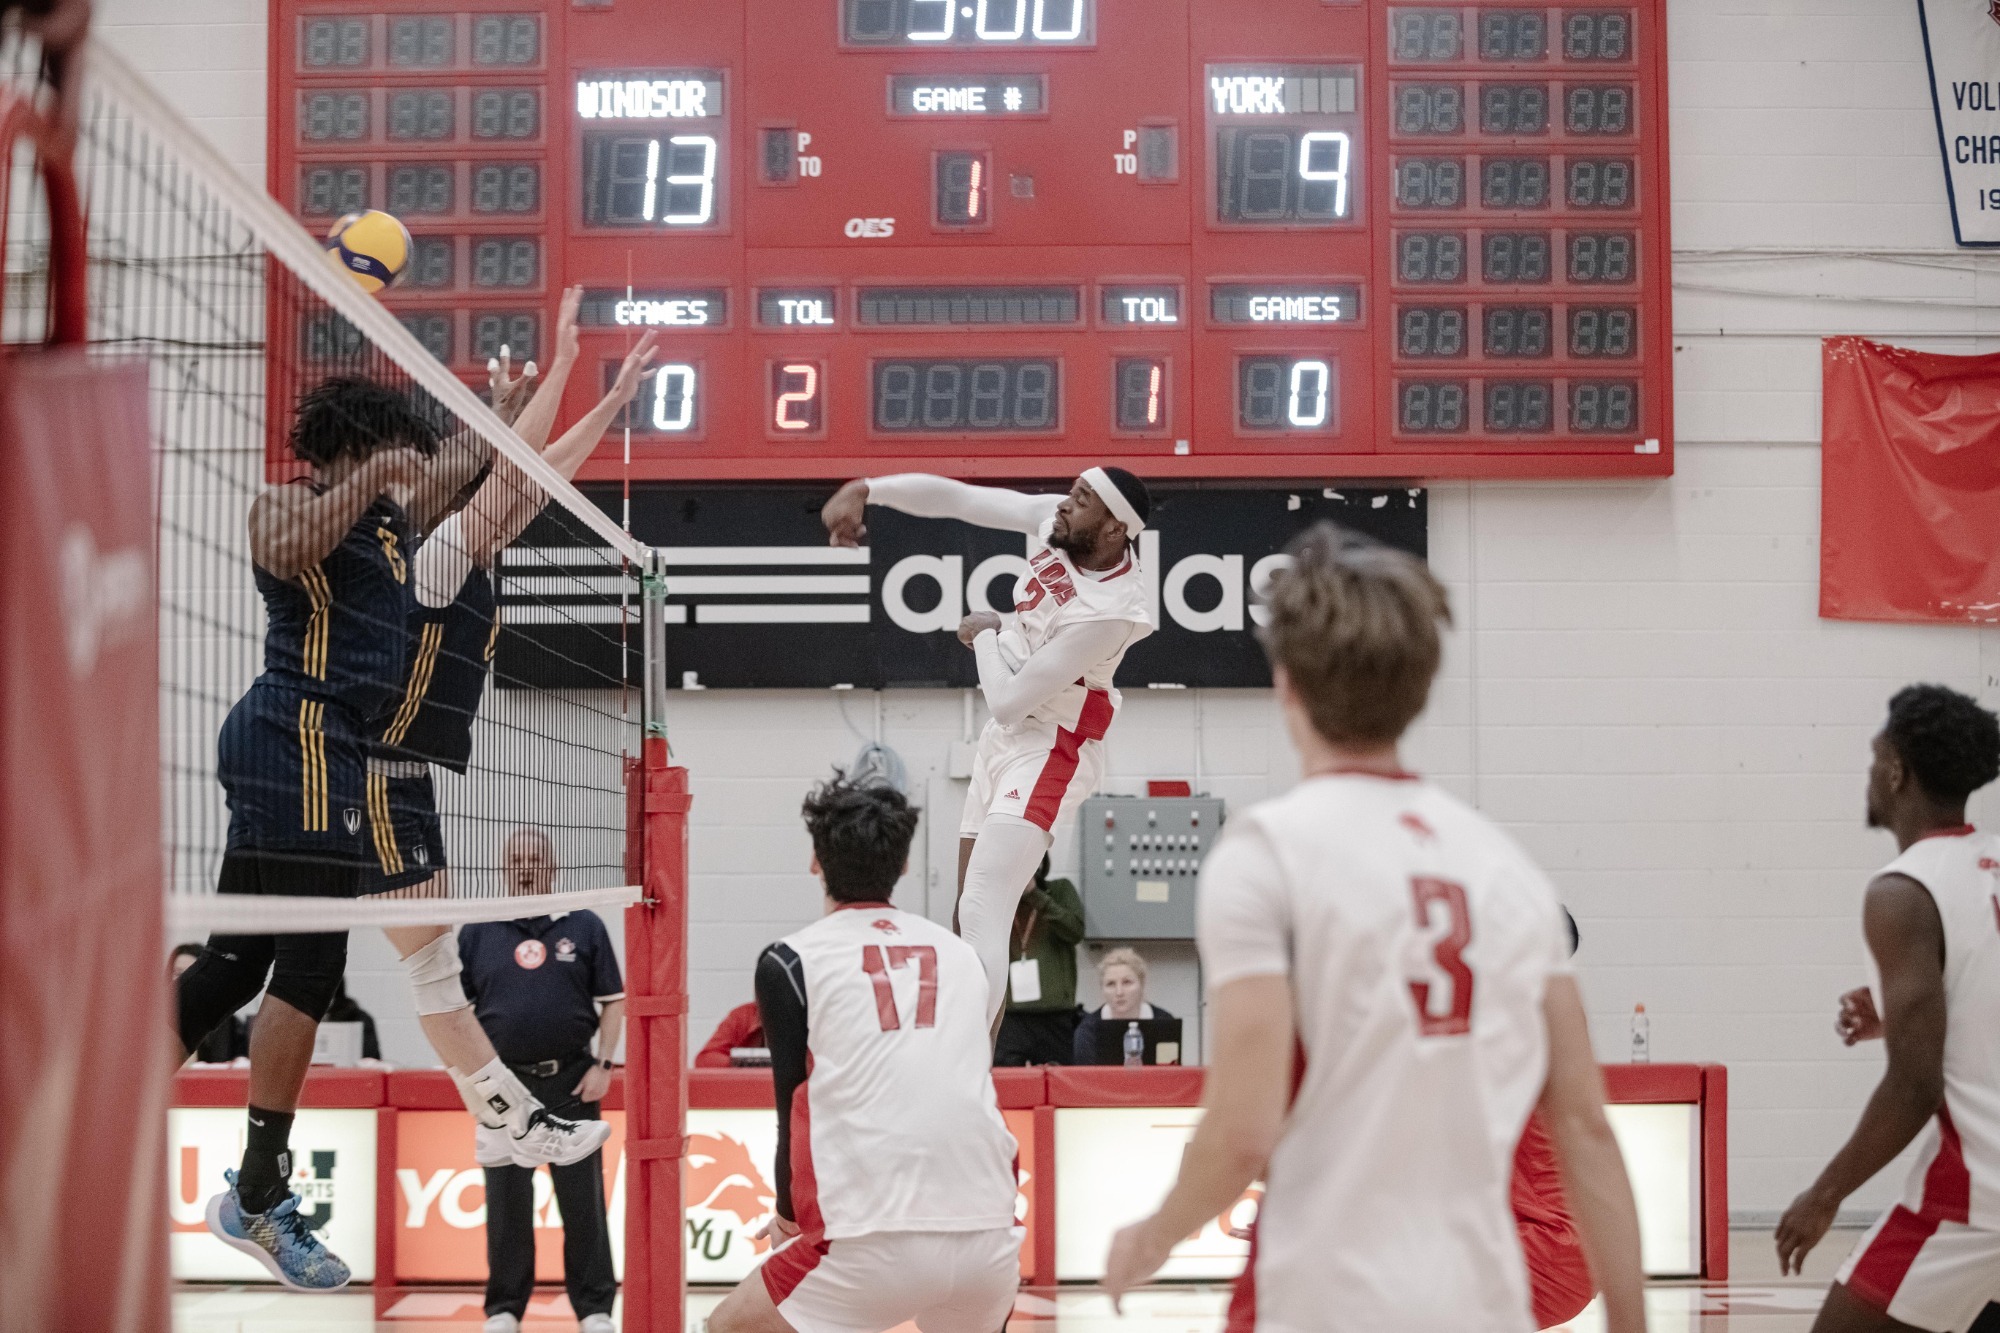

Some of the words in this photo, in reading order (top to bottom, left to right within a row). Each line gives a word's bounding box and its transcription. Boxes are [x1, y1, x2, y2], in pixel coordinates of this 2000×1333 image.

[577, 80, 706, 118] WINDSOR
[912, 87, 986, 111] GAME
[1003, 87, 1022, 111] #
[1211, 77, 1285, 113] YORK
[1952, 82, 2000, 111] VOL
[799, 133, 811, 152] P
[1124, 130, 1137, 149] P
[642, 136, 717, 224] 13
[799, 157, 821, 177] TO
[1114, 154, 1137, 174] TO
[1299, 132, 1350, 216] 9
[967, 160, 981, 217] 1
[844, 218, 895, 238] OES
[615, 301, 708, 325] GAMES
[778, 300, 834, 324] TOL
[1122, 298, 1177, 322] TOL
[1249, 297, 1340, 321] GAMES
[653, 365, 695, 430] 0
[776, 365, 816, 428] 2
[1147, 366, 1160, 424] 1
[1288, 361, 1328, 426] 0
[1408, 875, 1474, 1036] 3
[862, 945, 938, 1032] 17
